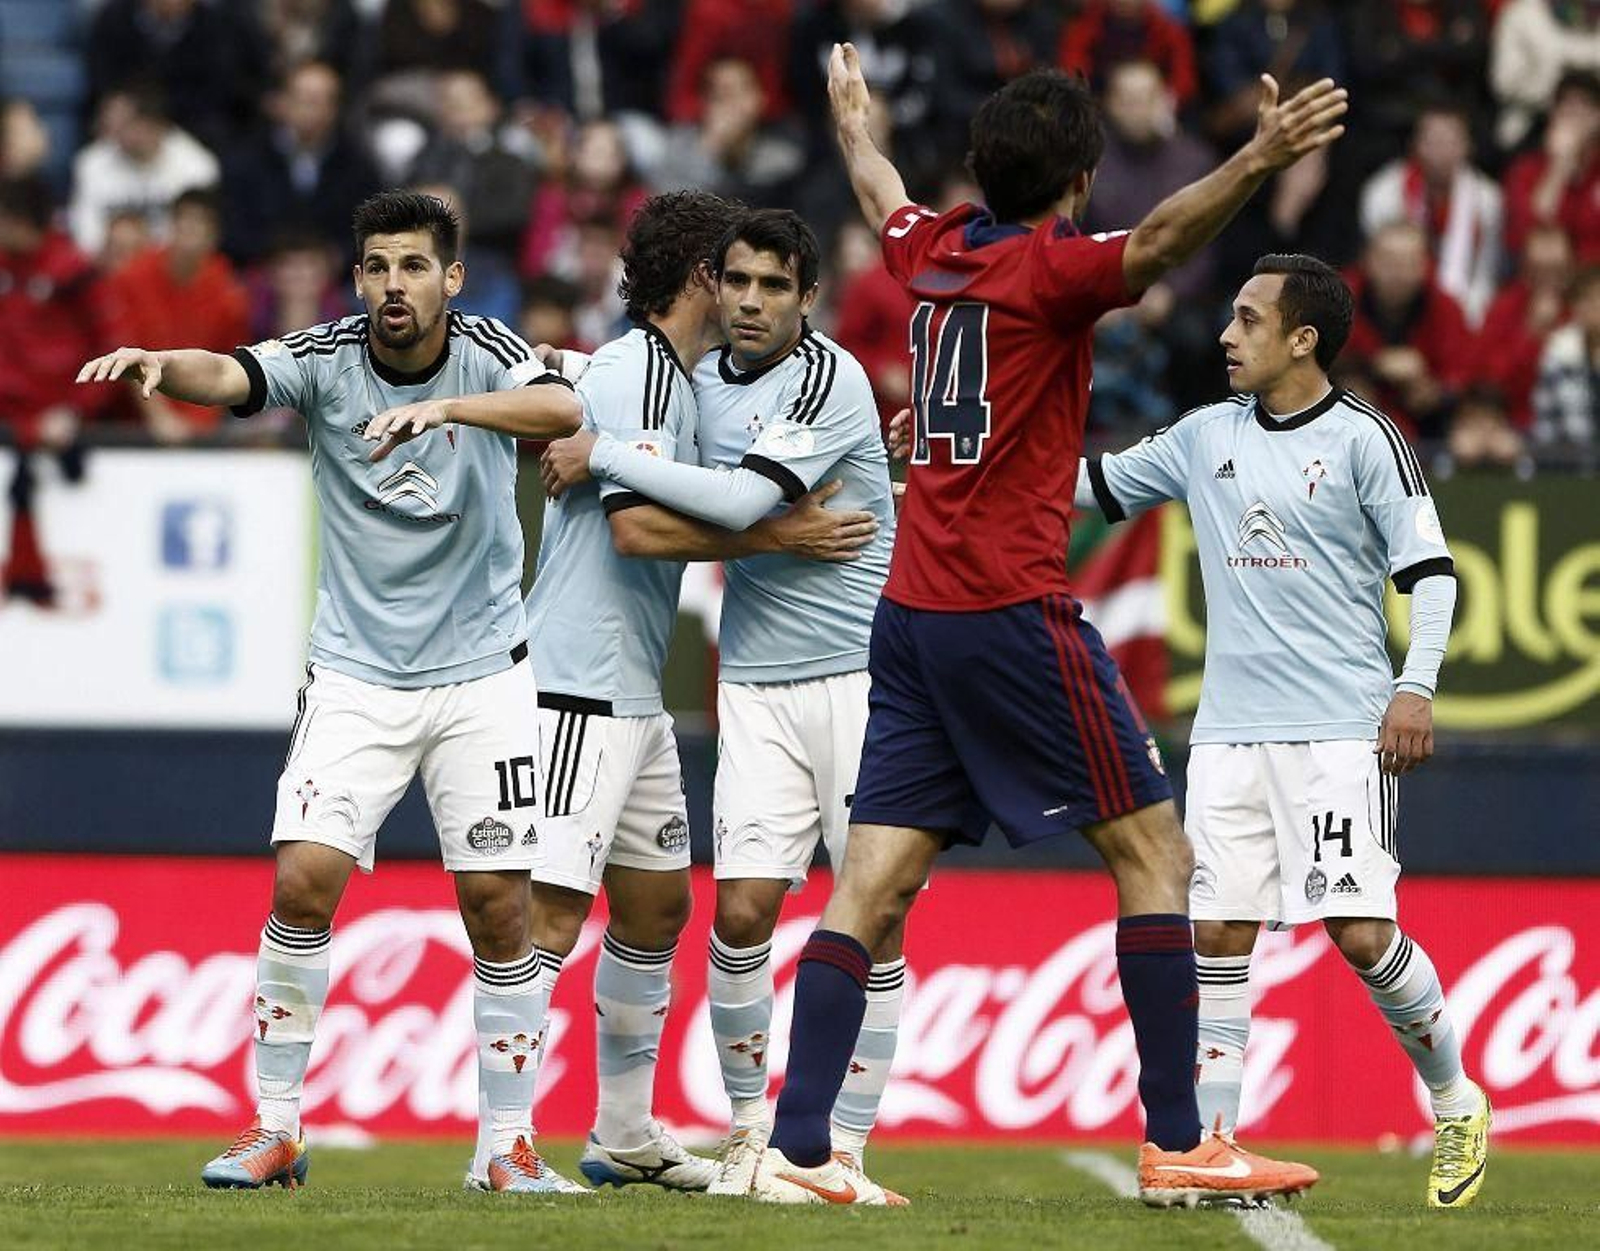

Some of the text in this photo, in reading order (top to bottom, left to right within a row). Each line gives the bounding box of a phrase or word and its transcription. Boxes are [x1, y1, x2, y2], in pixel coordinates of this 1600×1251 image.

[910, 302, 991, 465] 14
[494, 755, 537, 811] 10
[1312, 811, 1353, 863] 14
